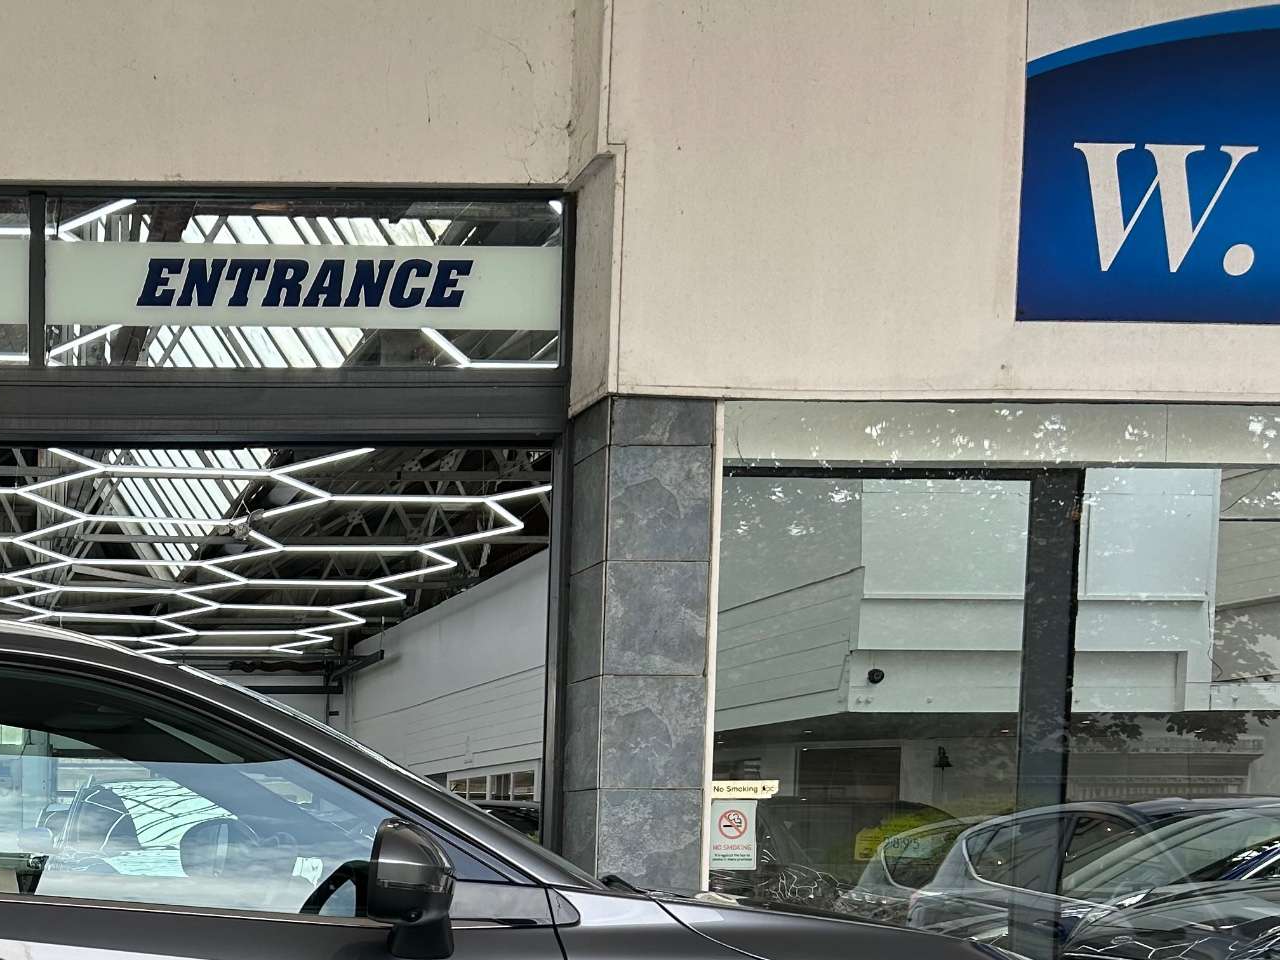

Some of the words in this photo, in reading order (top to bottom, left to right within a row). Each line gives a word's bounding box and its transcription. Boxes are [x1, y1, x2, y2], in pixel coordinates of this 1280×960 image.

[1073, 142, 1259, 276] W.
[136, 258, 474, 308] ENTRANCE
[713, 785, 724, 793] No
[726, 785, 758, 794] Smoking
